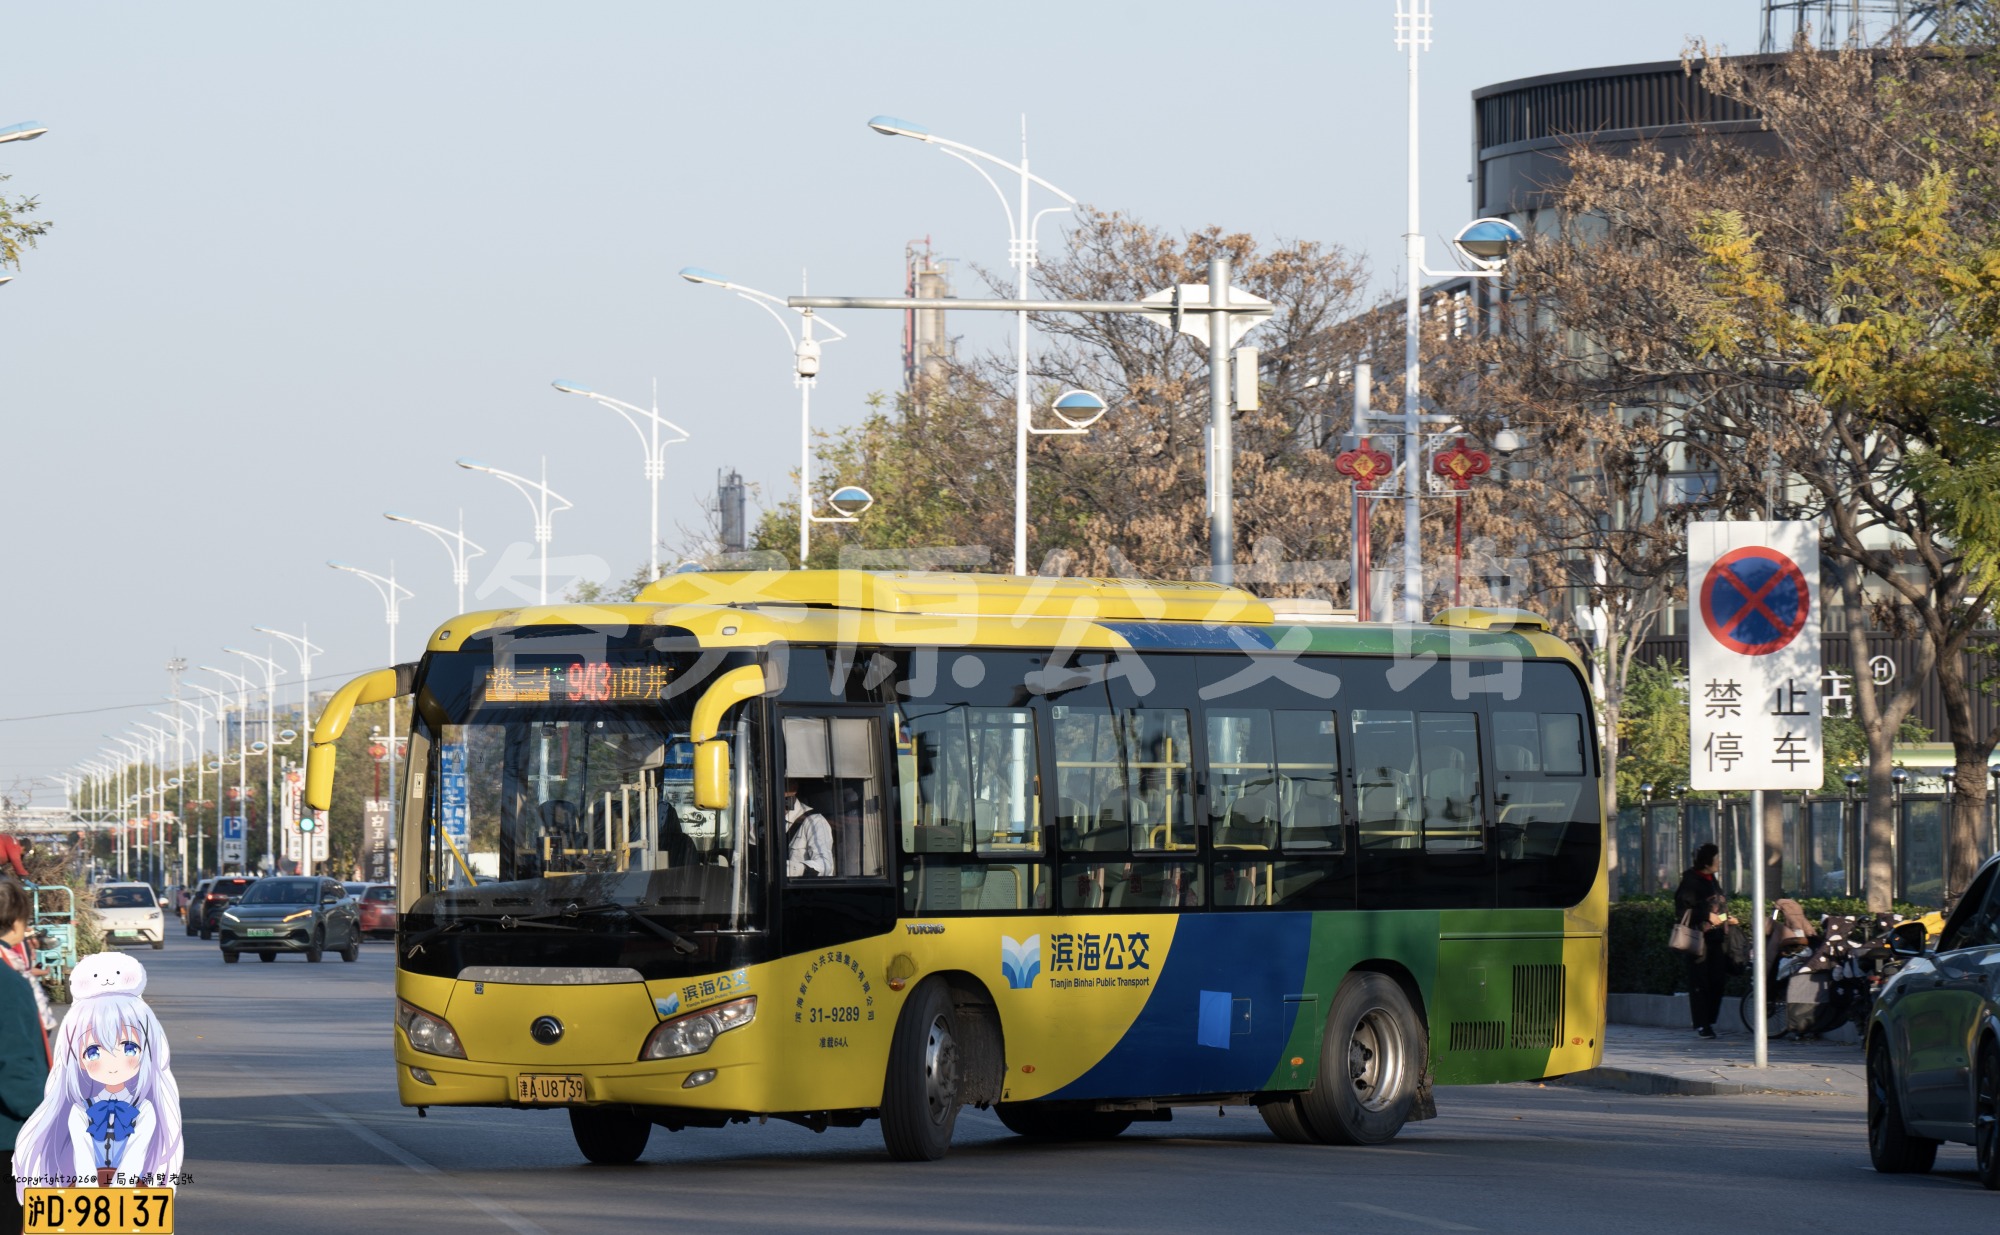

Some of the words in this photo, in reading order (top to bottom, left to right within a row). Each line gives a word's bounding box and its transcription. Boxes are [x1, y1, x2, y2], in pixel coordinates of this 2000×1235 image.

[568, 663, 612, 701] 943
[1704, 678, 1810, 719] 禁止
[1703, 731, 1811, 772] 停车
[229, 819, 241, 836] P
[905, 923, 946, 935] YUTONG
[1050, 932, 1150, 971] 滨海公交
[682, 968, 749, 1002] 滨海公交
[795, 951, 875, 1023] 滨海新区公共交通集团有限公司
[1050, 978, 1073, 989] Tianjin
[1074, 978, 1095, 988] Binhai
[1096, 977, 1116, 987] Public
[1117, 976, 1150, 988] Transport
[809, 1006, 860, 1023] 31-9289
[819, 1036, 848, 1048] 准载64人
